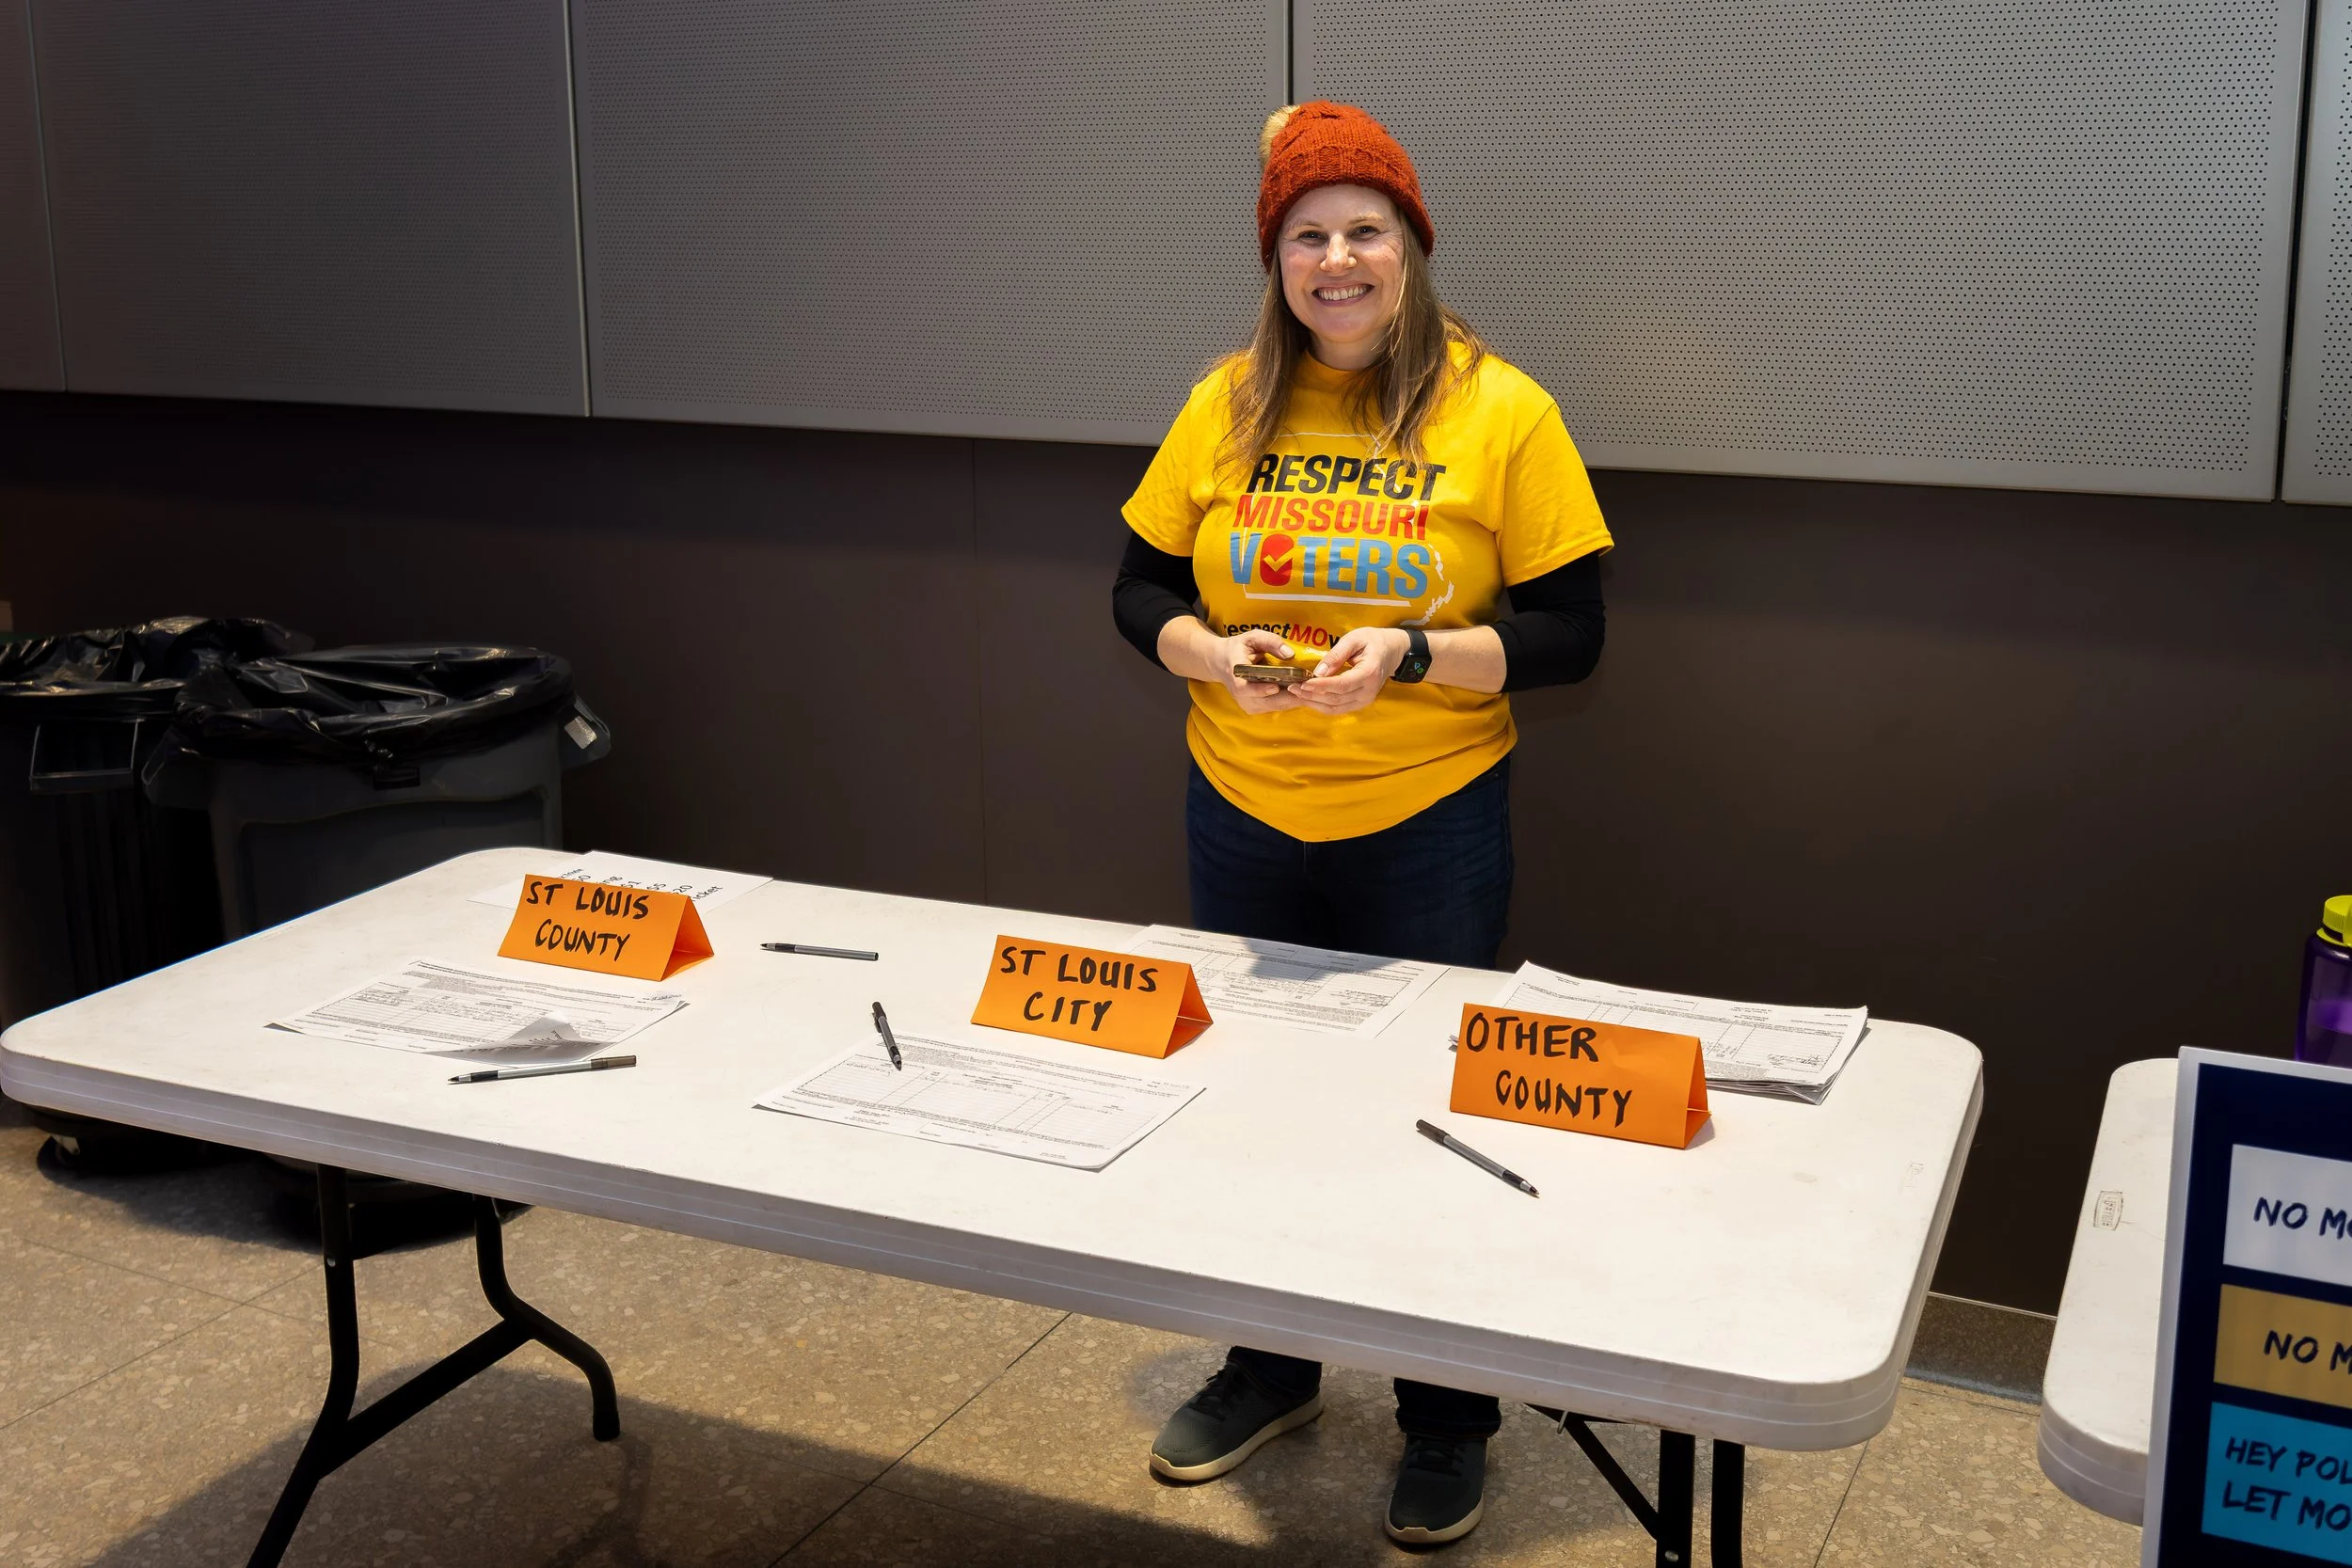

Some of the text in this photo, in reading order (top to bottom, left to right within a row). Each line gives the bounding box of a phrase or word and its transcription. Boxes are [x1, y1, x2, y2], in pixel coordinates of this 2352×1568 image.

[1248, 454, 1446, 500] RESPECT
[1233, 495, 1429, 540] MISSOURI
[1230, 532, 1430, 598] VOTERS
[526, 881, 649, 919] ST LOUIS
[535, 918, 630, 961] COUNTY
[1000, 946, 1046, 975] ST
[1057, 954, 1158, 992] LOUIS
[1024, 991, 1112, 1031] CITY
[1466, 1012, 1598, 1062] OTHER
[1495, 1069, 1632, 1128] COUNTY
[2253, 1196, 2352, 1240] NO M
[2264, 1330, 2318, 1364] NO
[2225, 1435, 2352, 1485] HEY POL
[2222, 1480, 2352, 1531] LET MO
